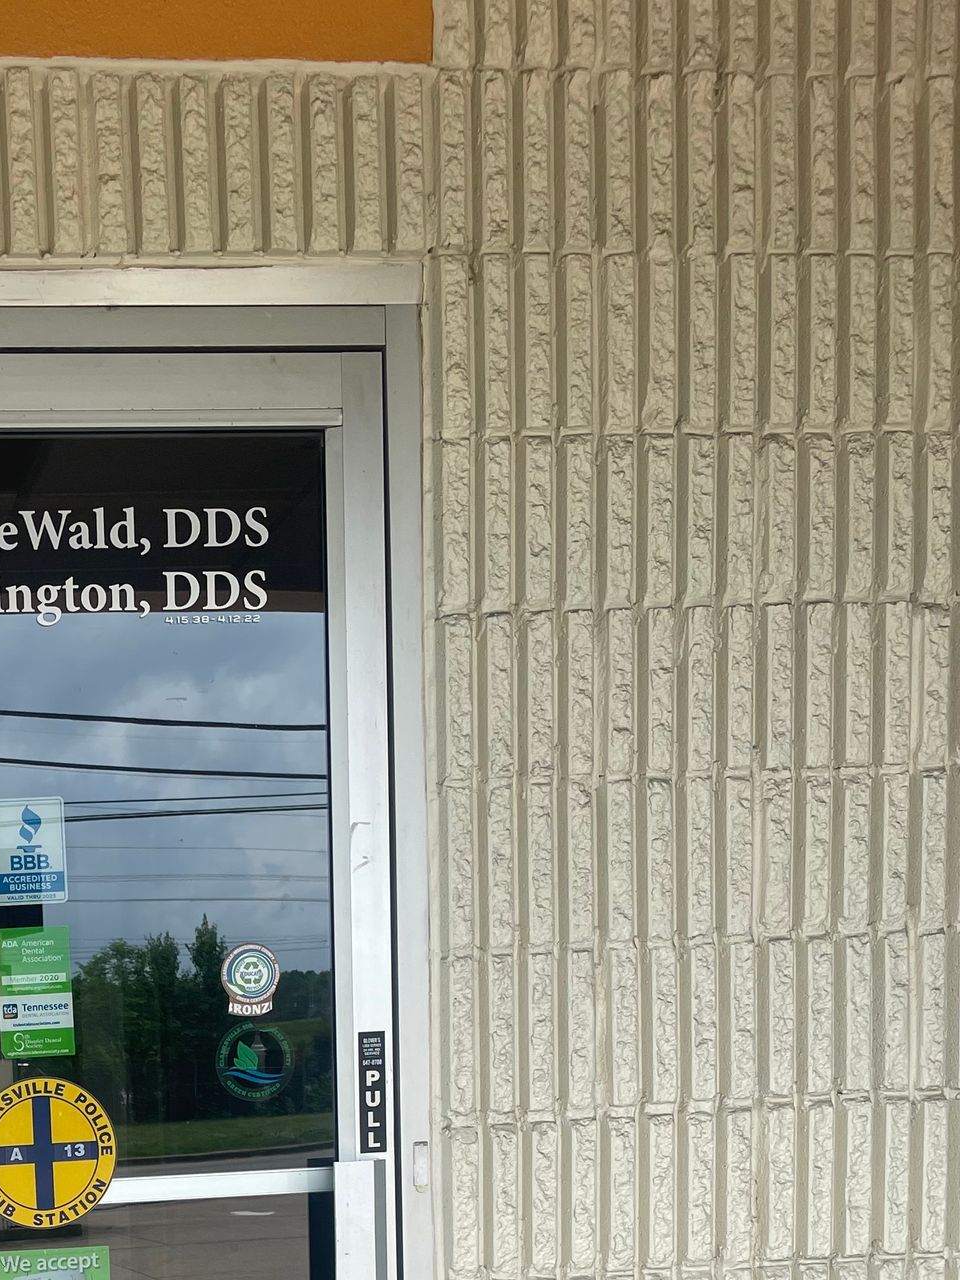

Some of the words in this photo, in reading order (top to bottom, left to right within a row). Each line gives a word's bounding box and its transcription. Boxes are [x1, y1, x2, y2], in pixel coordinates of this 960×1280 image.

[162, 506, 270, 550] DDS
[162, 569, 268, 612] DDS
[10, 854, 49, 871] BBB
[3, 874, 58, 884] ACCREDITED
[10, 882, 51, 891] BUSINESS
[2, 940, 18, 948] ADA
[21, 939, 54, 947] American
[22, 947, 45, 955] Dental
[3, 1005, 17, 1015] tda
[22, 1002, 69, 1012] Tennessee
[228, 1001, 273, 1015] BRONZ
[366, 1070, 381, 1148] PULL
[74, 1092, 113, 1156] POLICE
[10, 1148, 23, 1161] A
[64, 1144, 85, 1158] 13
[33, 1178, 107, 1226] STATION
[0, 1255, 31, 1273] We
[37, 1253, 99, 1273] accept
